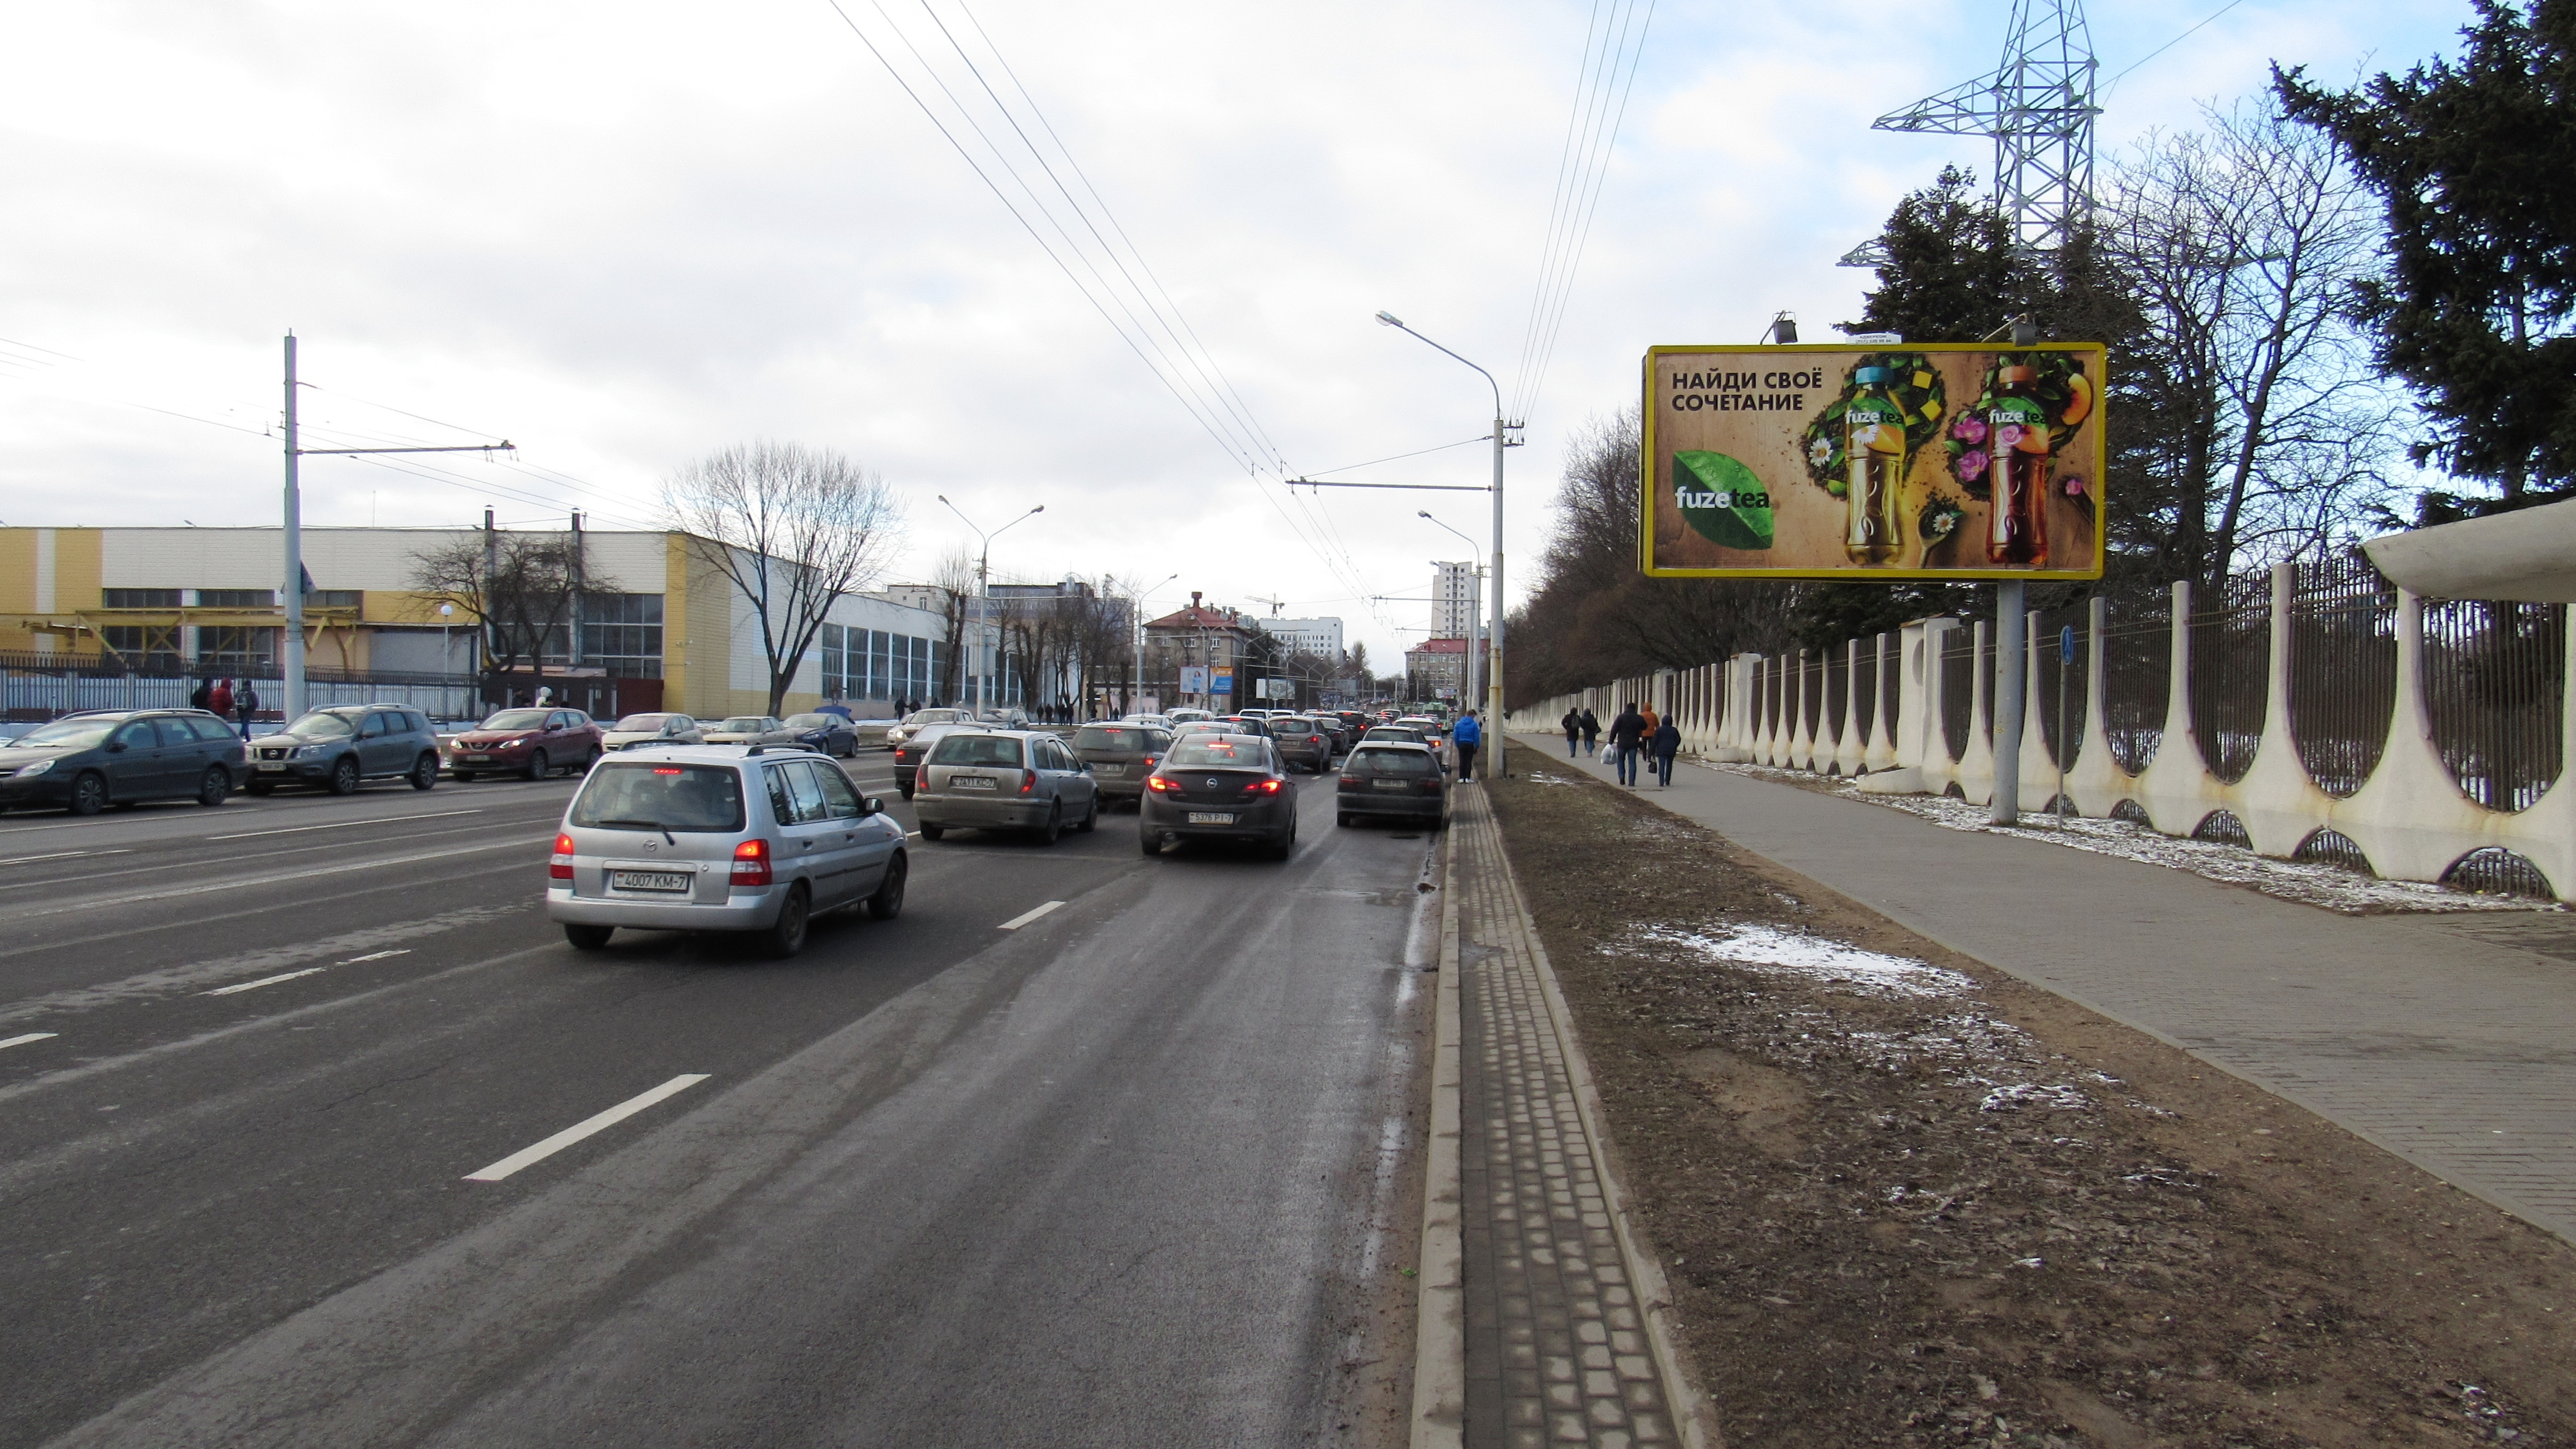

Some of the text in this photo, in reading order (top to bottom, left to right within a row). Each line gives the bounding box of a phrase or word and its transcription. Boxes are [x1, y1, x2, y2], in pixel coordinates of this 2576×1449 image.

[1672, 367, 1822, 392] НАЙДИ СВОЁ
[1671, 394, 1803, 411] СОЧЕТАНИЕ
[625, 874, 685, 888] 4007 KM-7
